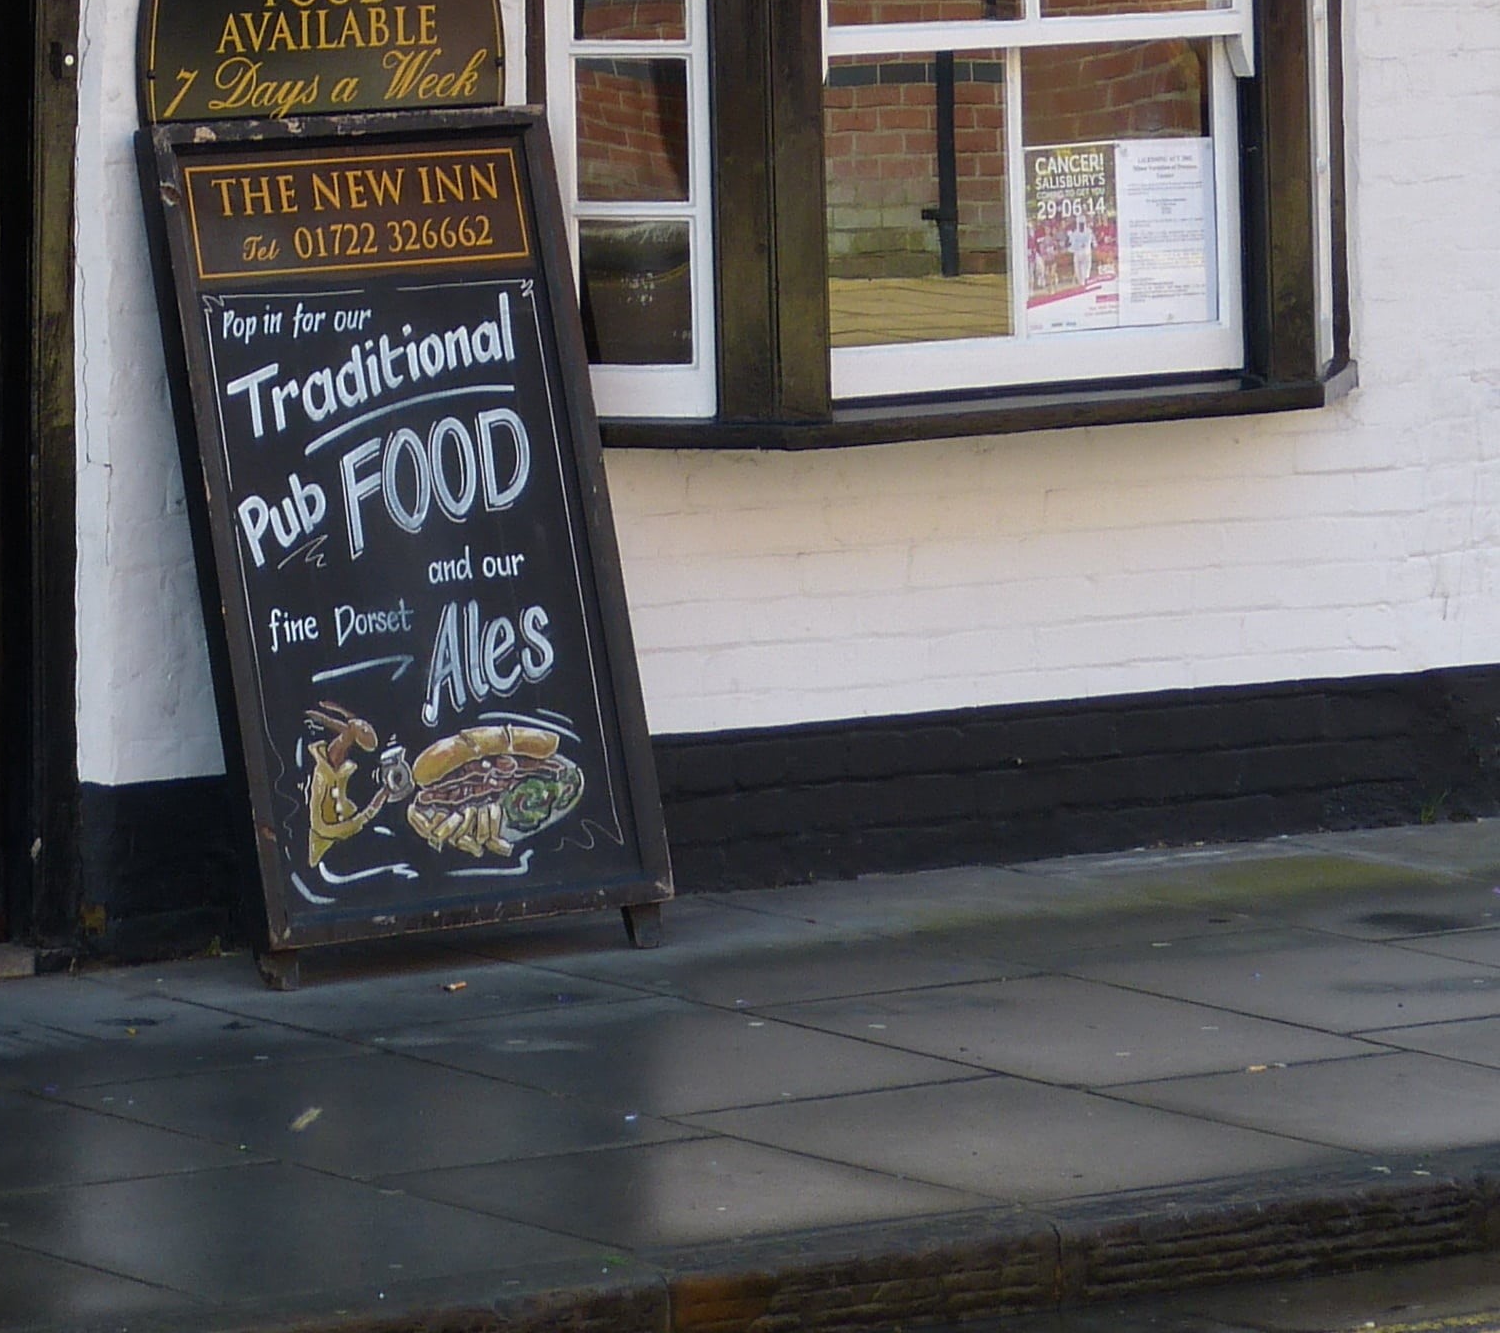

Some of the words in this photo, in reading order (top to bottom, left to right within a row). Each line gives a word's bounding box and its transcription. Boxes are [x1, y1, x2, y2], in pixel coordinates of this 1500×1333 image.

[215, 5, 438, 54] AVAILABLE
[163, 69, 198, 118] 7
[208, 57, 320, 122] Days
[330, 79, 358, 103] a
[382, 48, 488, 101] Week
[1035, 153, 1104, 175] CANCER!
[1035, 173, 1106, 191] SALISBURY'S
[211, 173, 299, 217] THE
[310, 167, 407, 211] NEW
[417, 162, 499, 205] INN
[242, 235, 280, 263] Tel
[293, 222, 379, 259] 01722
[388, 215, 494, 252] 326662
[223, 309, 257, 345] Pop
[263, 304, 283, 334] in
[292, 302, 326, 339] for
[333, 308, 372, 332] our
[226, 292, 516, 439] Traditional
[237, 473, 328, 569] Pub
[339, 407, 531, 560] FOOD
[428, 545, 472, 585] and
[482, 552, 525, 577] our
[268, 607, 319, 653] fine
[334, 598, 415, 648] Dorset
[420, 598, 555, 728] Ales
